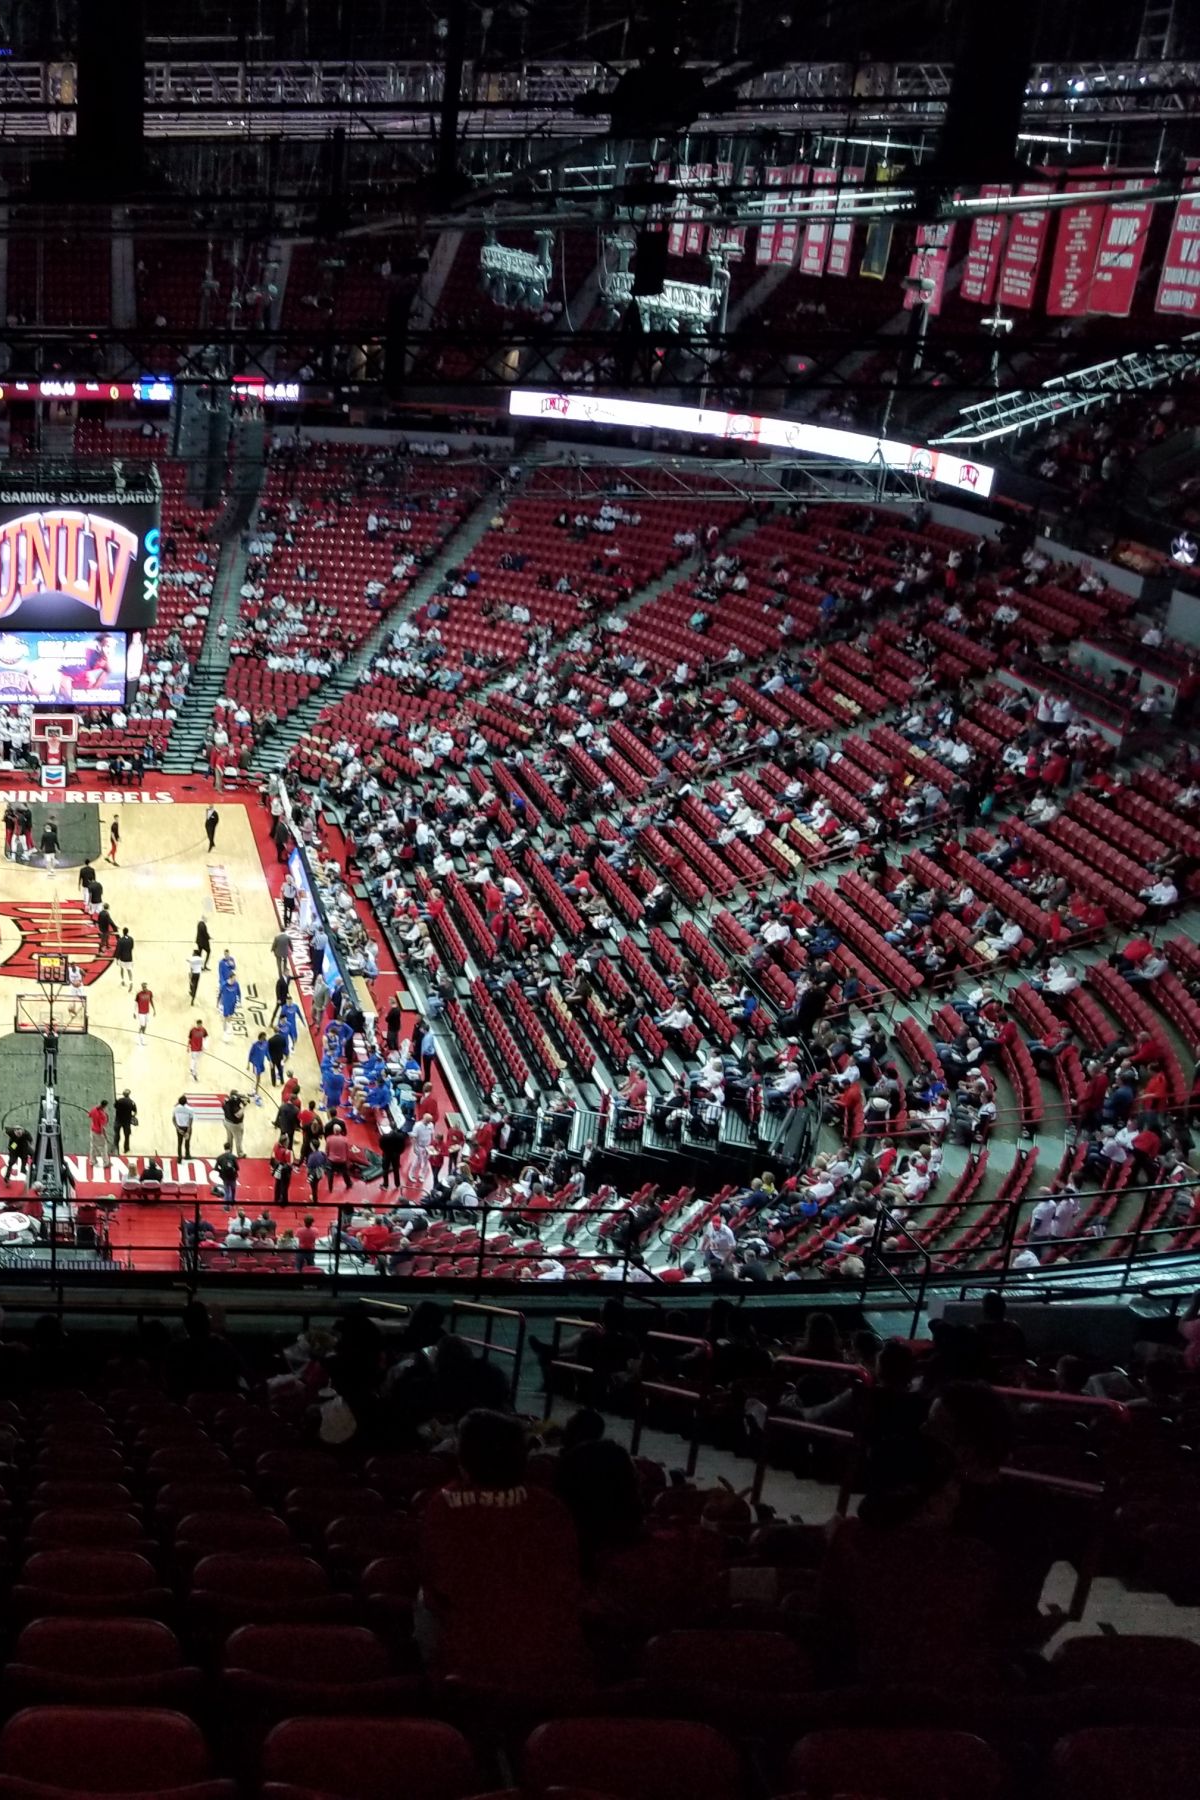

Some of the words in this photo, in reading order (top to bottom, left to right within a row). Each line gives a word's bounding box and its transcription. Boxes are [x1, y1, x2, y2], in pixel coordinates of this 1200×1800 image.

[1, 491, 56, 504] GAMING
[61, 491, 154, 504] SCOREBOARD
[143, 529, 160, 600] COX
[65, 791, 175, 803] REBELS
[232, 1012, 249, 1038] FIRST
